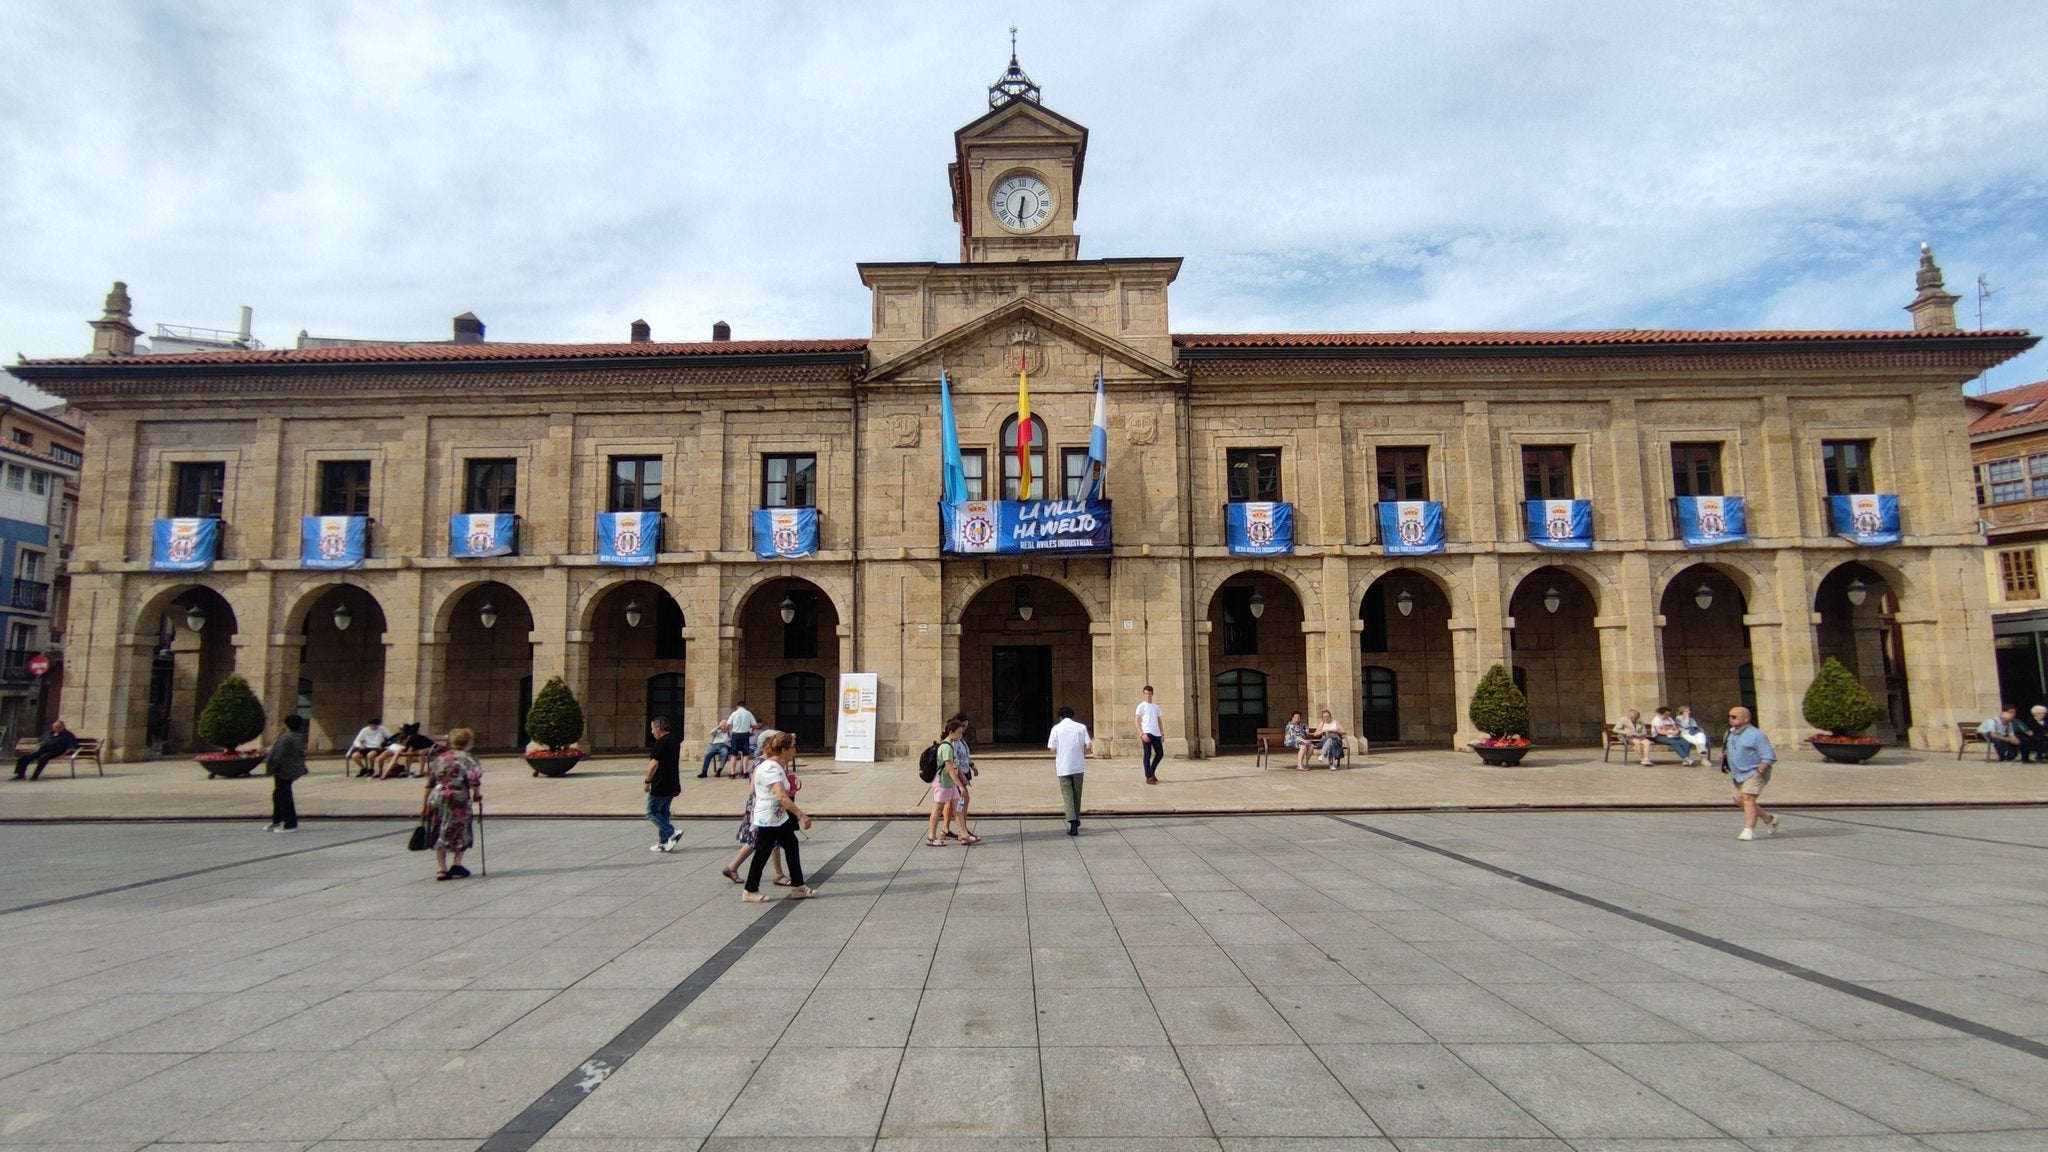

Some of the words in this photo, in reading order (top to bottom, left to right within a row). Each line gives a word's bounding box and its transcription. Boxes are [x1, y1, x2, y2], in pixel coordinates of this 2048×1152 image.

[1020, 503, 1041, 520] LA
[1045, 500, 1086, 517] VILLA
[1014, 521, 1037, 539] HA
[1040, 514, 1096, 536] VUELTO
[1021, 541, 1035, 550] REAL
[1058, 539, 1094, 547] INDUSTRIAL
